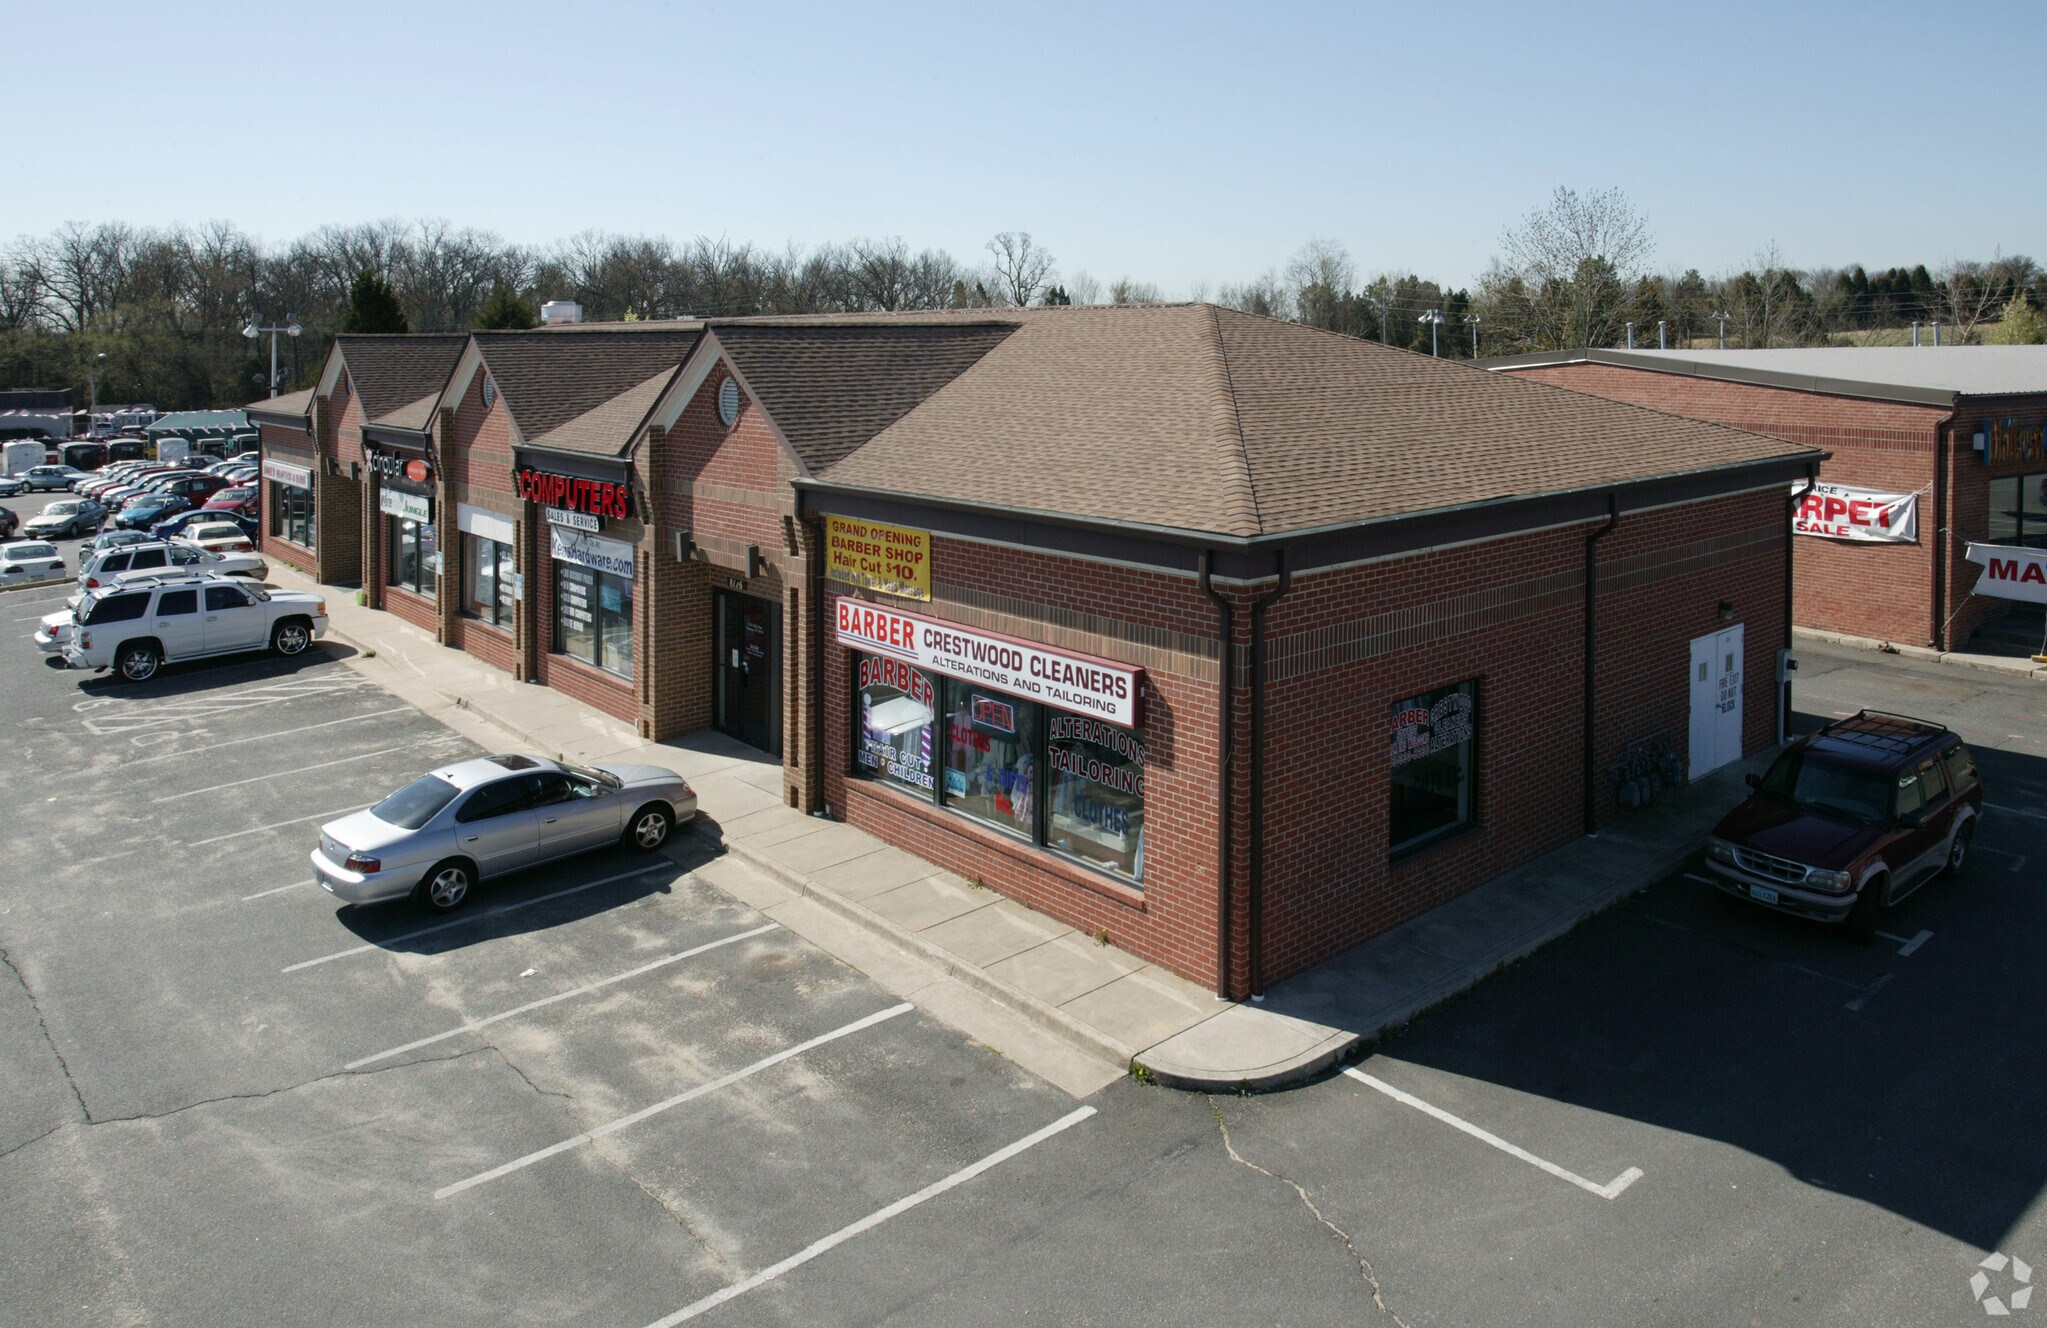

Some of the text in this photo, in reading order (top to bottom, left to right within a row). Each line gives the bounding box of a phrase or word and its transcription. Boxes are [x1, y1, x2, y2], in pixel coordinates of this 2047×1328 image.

[373, 449, 404, 480] cingular
[520, 468, 628, 520] COMPUTERS
[546, 509, 598, 529] SALES & SERVICE
[832, 521, 922, 548] GRAND OPENING
[1796, 520, 1851, 537] SALE
[831, 536, 924, 565] BARBER SHOP
[833, 550, 857, 569] Hair
[860, 557, 882, 574] Cut
[1989, 557, 2047, 585] MA
[838, 604, 915, 650] BARBER
[923, 628, 1128, 700] CRESTWOOD CLEANERS
[860, 656, 935, 714] BARBER
[932, 655, 1116, 714] ALTERATIONS AND TAILORING
[1718, 672, 1740, 689] FIRE EXIT
[1720, 686, 1737, 702] DO NOT
[974, 698, 1013, 731] OPEN
[1389, 708, 1430, 734] ARBER
[1430, 693, 1472, 727] CRESTWOOD
[1721, 699, 1736, 714] BLOCK
[1430, 723, 1473, 755] ALTERATIONS
[1434, 711, 1469, 736] CLEANERS
[1050, 716, 1146, 768] ALTERATIONS
[858, 750, 878, 769] MEN
[887, 760, 935, 791] CHILDREN
[899, 751, 923, 770] CUT
[1049, 746, 1146, 799] TAILORING
[1074, 800, 1130, 836] CLOTHES
